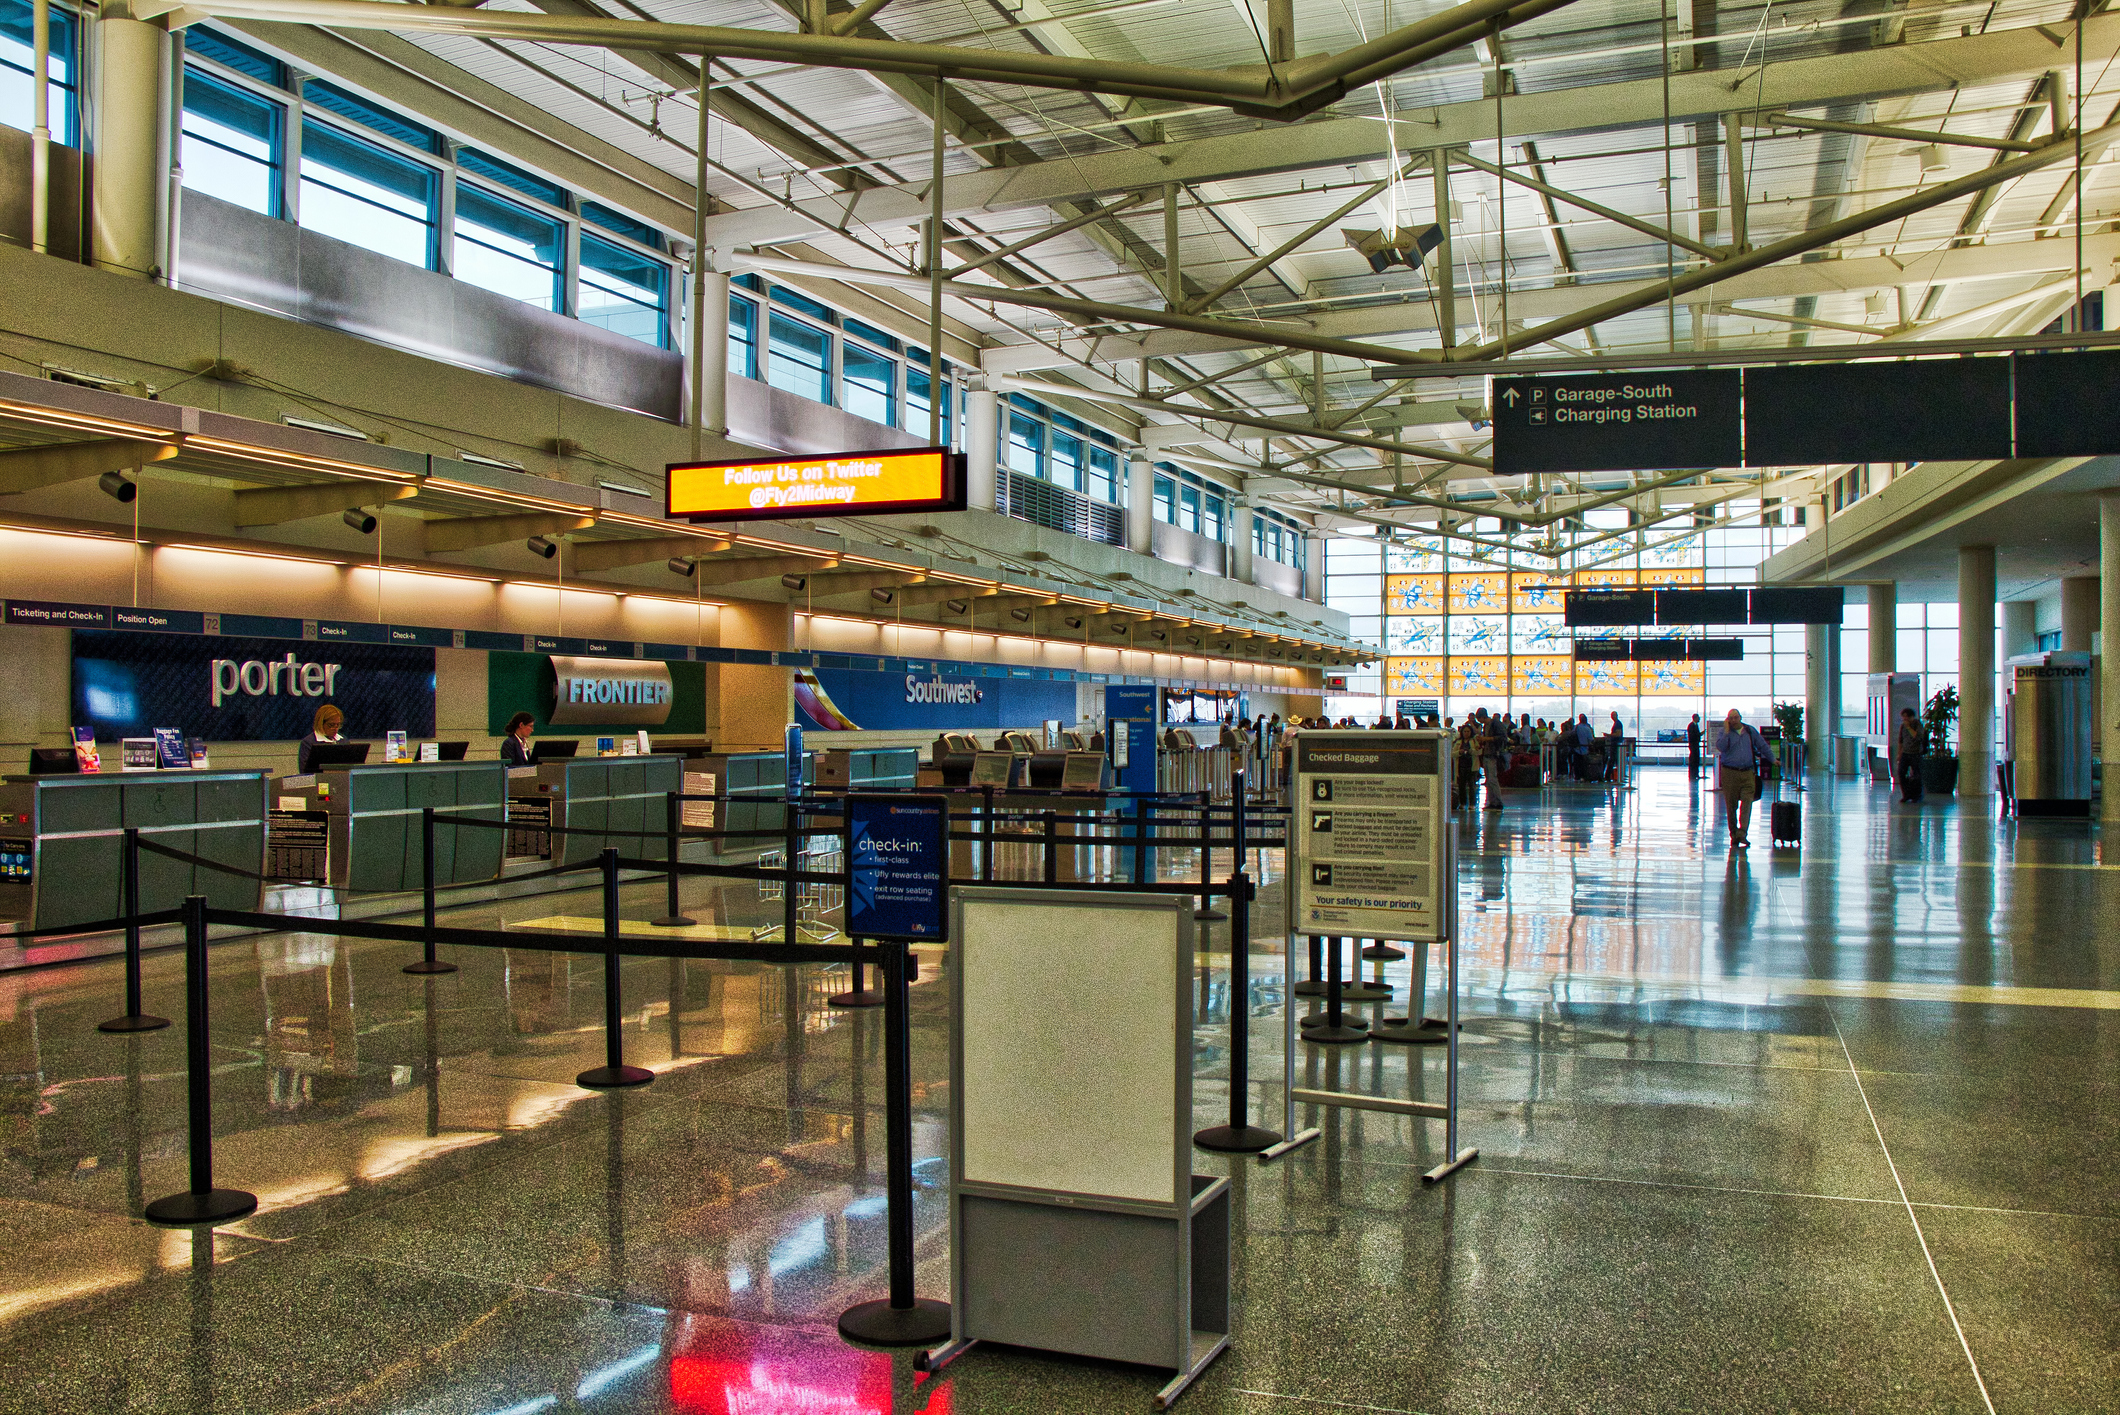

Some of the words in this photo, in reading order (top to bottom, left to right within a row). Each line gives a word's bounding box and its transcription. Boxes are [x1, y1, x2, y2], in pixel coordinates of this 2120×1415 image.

[1533, 390, 1543, 402] P
[1554, 384, 1672, 403] Garage-South
[1554, 405, 1631, 424] Charging
[1636, 404, 1697, 420] Station
[725, 468, 773, 485] Follow
[777, 466, 797, 481] Us
[802, 466, 822, 480] on
[827, 461, 882, 478] Twitter
[749, 485, 856, 508] @Fly2Midway
[1586, 594, 1631, 602] Garage-South
[12, 607, 50, 619] Ticketing
[52, 610, 67, 619] and
[68, 610, 104, 621] Check-In
[117, 614, 147, 624] Position
[148, 616, 168, 626] Open
[205, 618, 219, 630] 72
[304, 624, 316, 636] 73
[321, 626, 347, 636] Check-In
[392, 631, 416, 640] Check-In
[454, 634, 464, 645] 74
[525, 639, 534, 649] 75
[2016, 667, 2088, 678] DIRECTORY
[211, 652, 342, 708] porter
[568, 677, 668, 705] FRONTIER
[905, 674, 976, 704] Southwest
[1309, 753, 1343, 762] Checked
[1344, 754, 1380, 763] Baggage
[859, 838, 923, 852] check-in:
[874, 856, 909, 864] first-class
[874, 871, 889, 880] Ufly
[892, 872, 922, 880] rewards
[923, 872, 940, 880] elite
[905, 887, 933, 896] seating
[1316, 896, 1335, 904] Your
[1336, 897, 1363, 907] safety
[1364, 898, 1372, 906] is
[1389, 900, 1422, 910] priority
